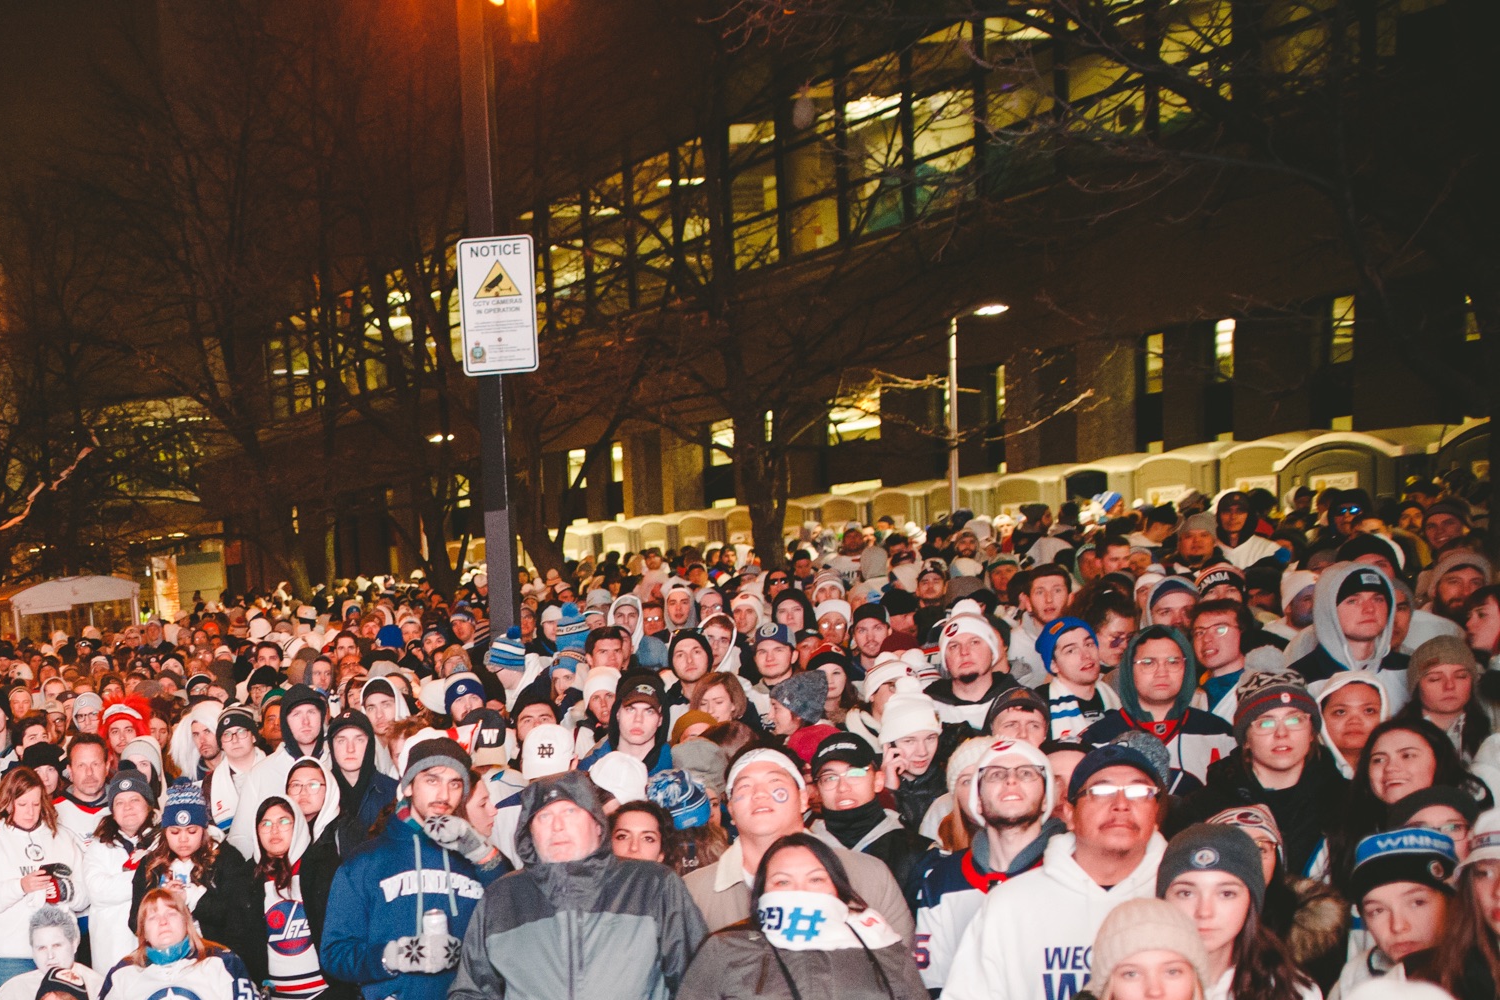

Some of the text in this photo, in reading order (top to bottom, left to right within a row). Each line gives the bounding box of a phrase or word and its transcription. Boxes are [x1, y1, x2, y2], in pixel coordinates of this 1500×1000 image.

[470, 243, 521, 258] NOTICE
[472, 297, 523, 307] CCTV CAMERAS
[484, 306, 520, 314] OPERATION
[481, 729, 499, 744] W
